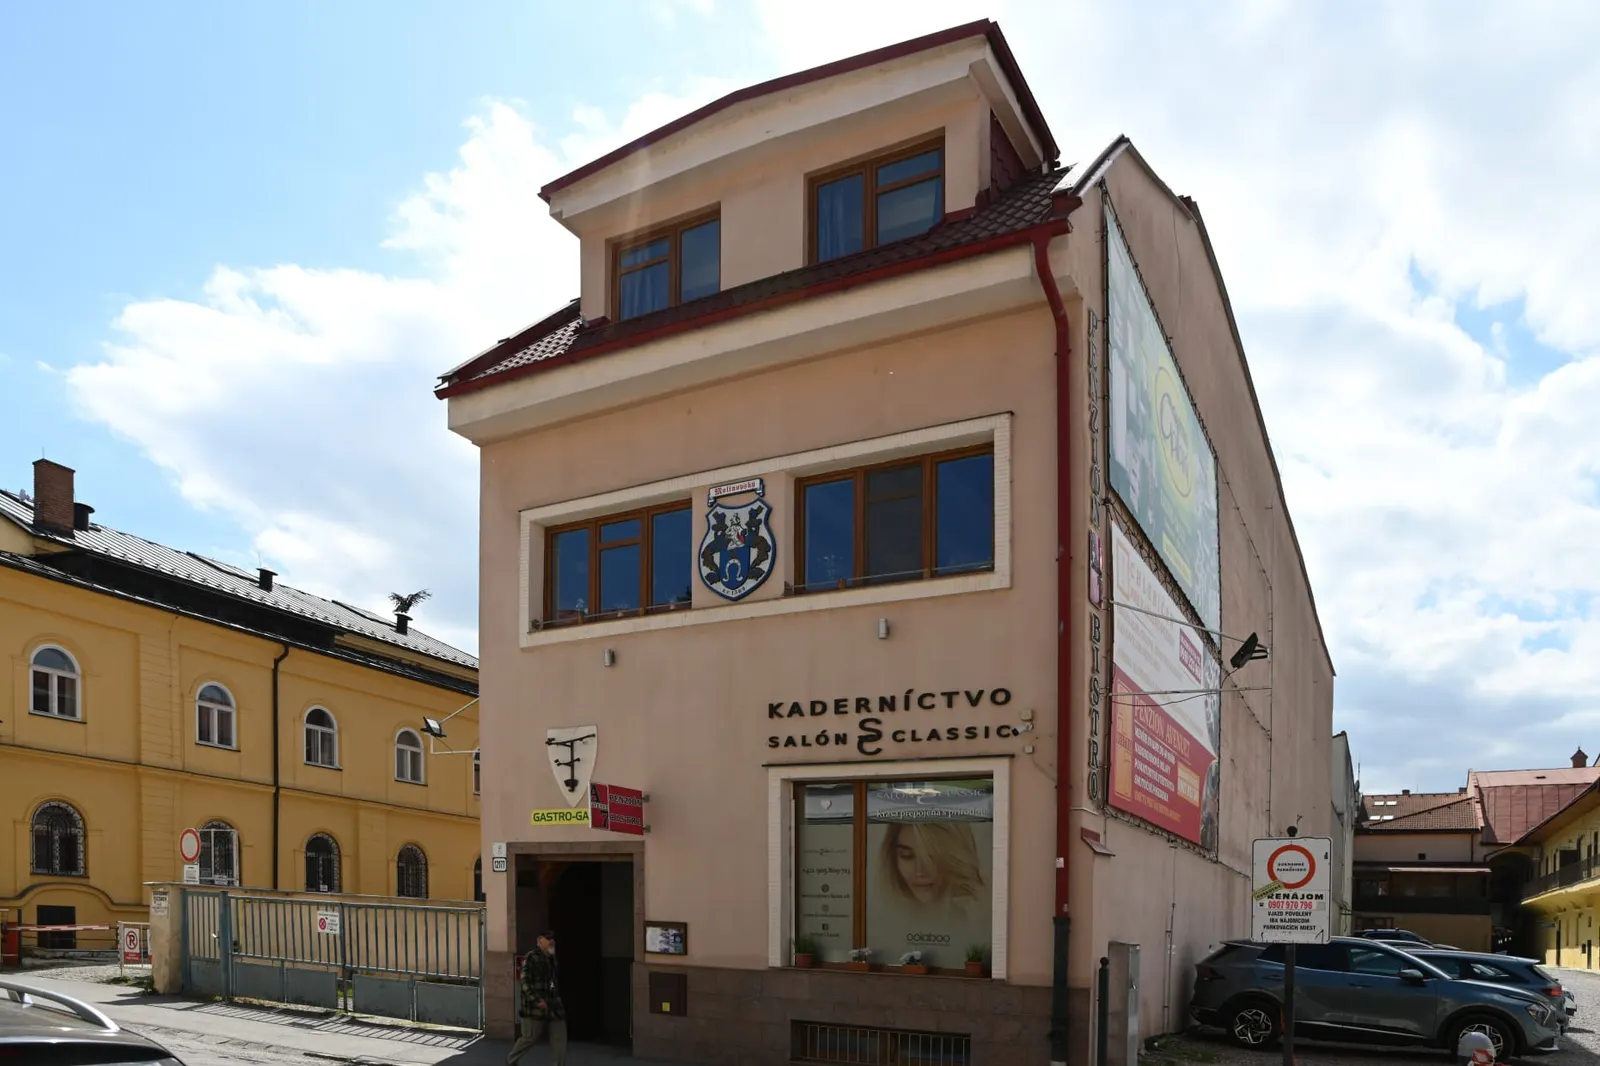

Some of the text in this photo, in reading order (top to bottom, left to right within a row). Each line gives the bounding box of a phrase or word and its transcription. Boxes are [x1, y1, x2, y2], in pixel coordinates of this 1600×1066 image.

[768, 688, 1011, 719] KADERNÍCTVO
[1089, 614, 1101, 800] BISTRO
[768, 730, 848, 748] SALÓN
[892, 724, 1012, 743] CLASSIC
[1266, 891, 1324, 901] RENÁJOM
[1268, 900, 1284, 909] 0907
[1286, 900, 1299, 909] 970
